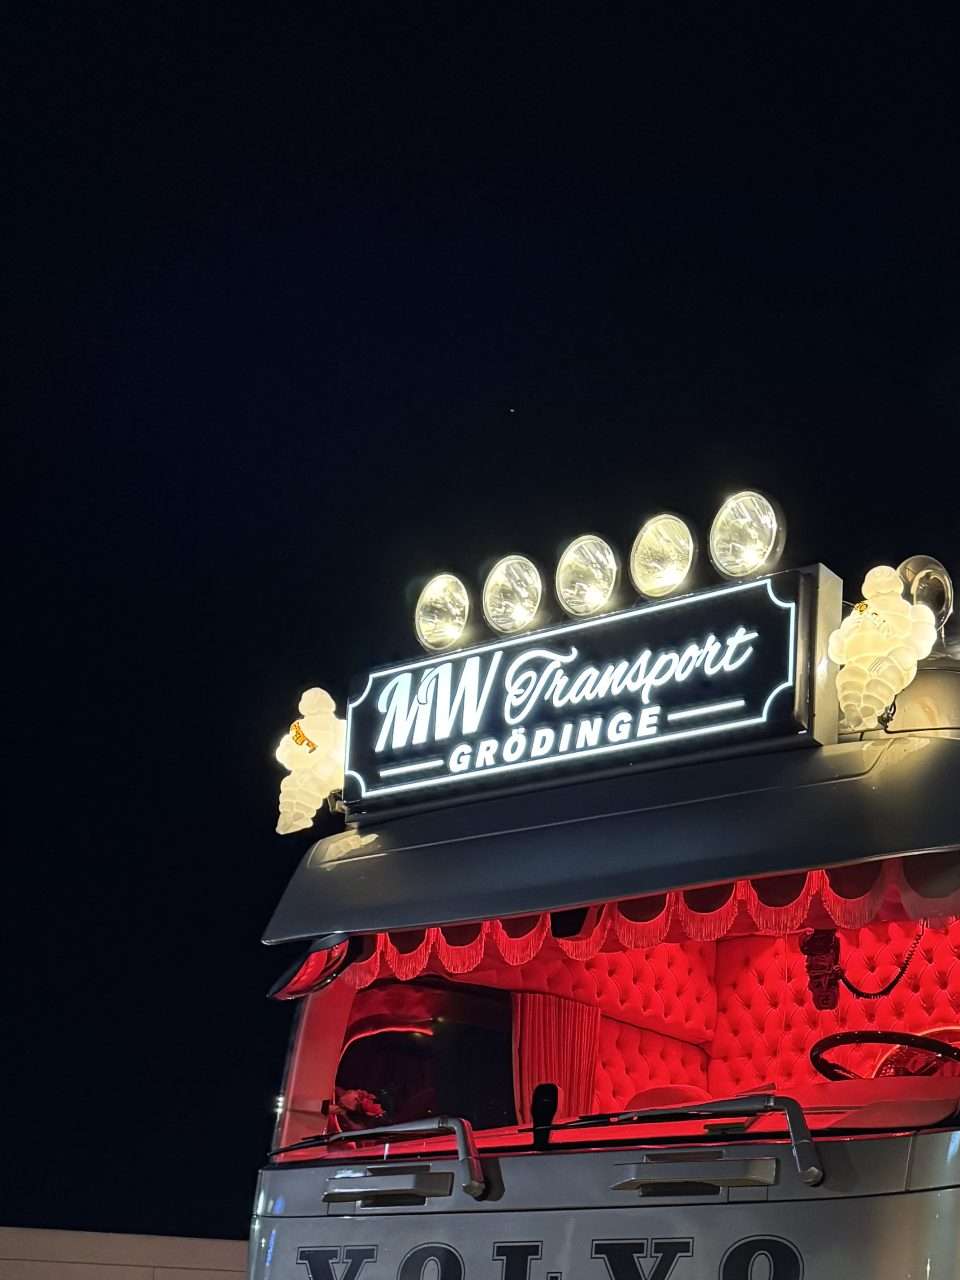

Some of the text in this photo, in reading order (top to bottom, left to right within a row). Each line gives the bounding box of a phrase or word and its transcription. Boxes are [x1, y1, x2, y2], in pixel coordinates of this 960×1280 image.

[375, 627, 760, 753] MW Transport
[448, 705, 661, 774] GRÖDINGE
